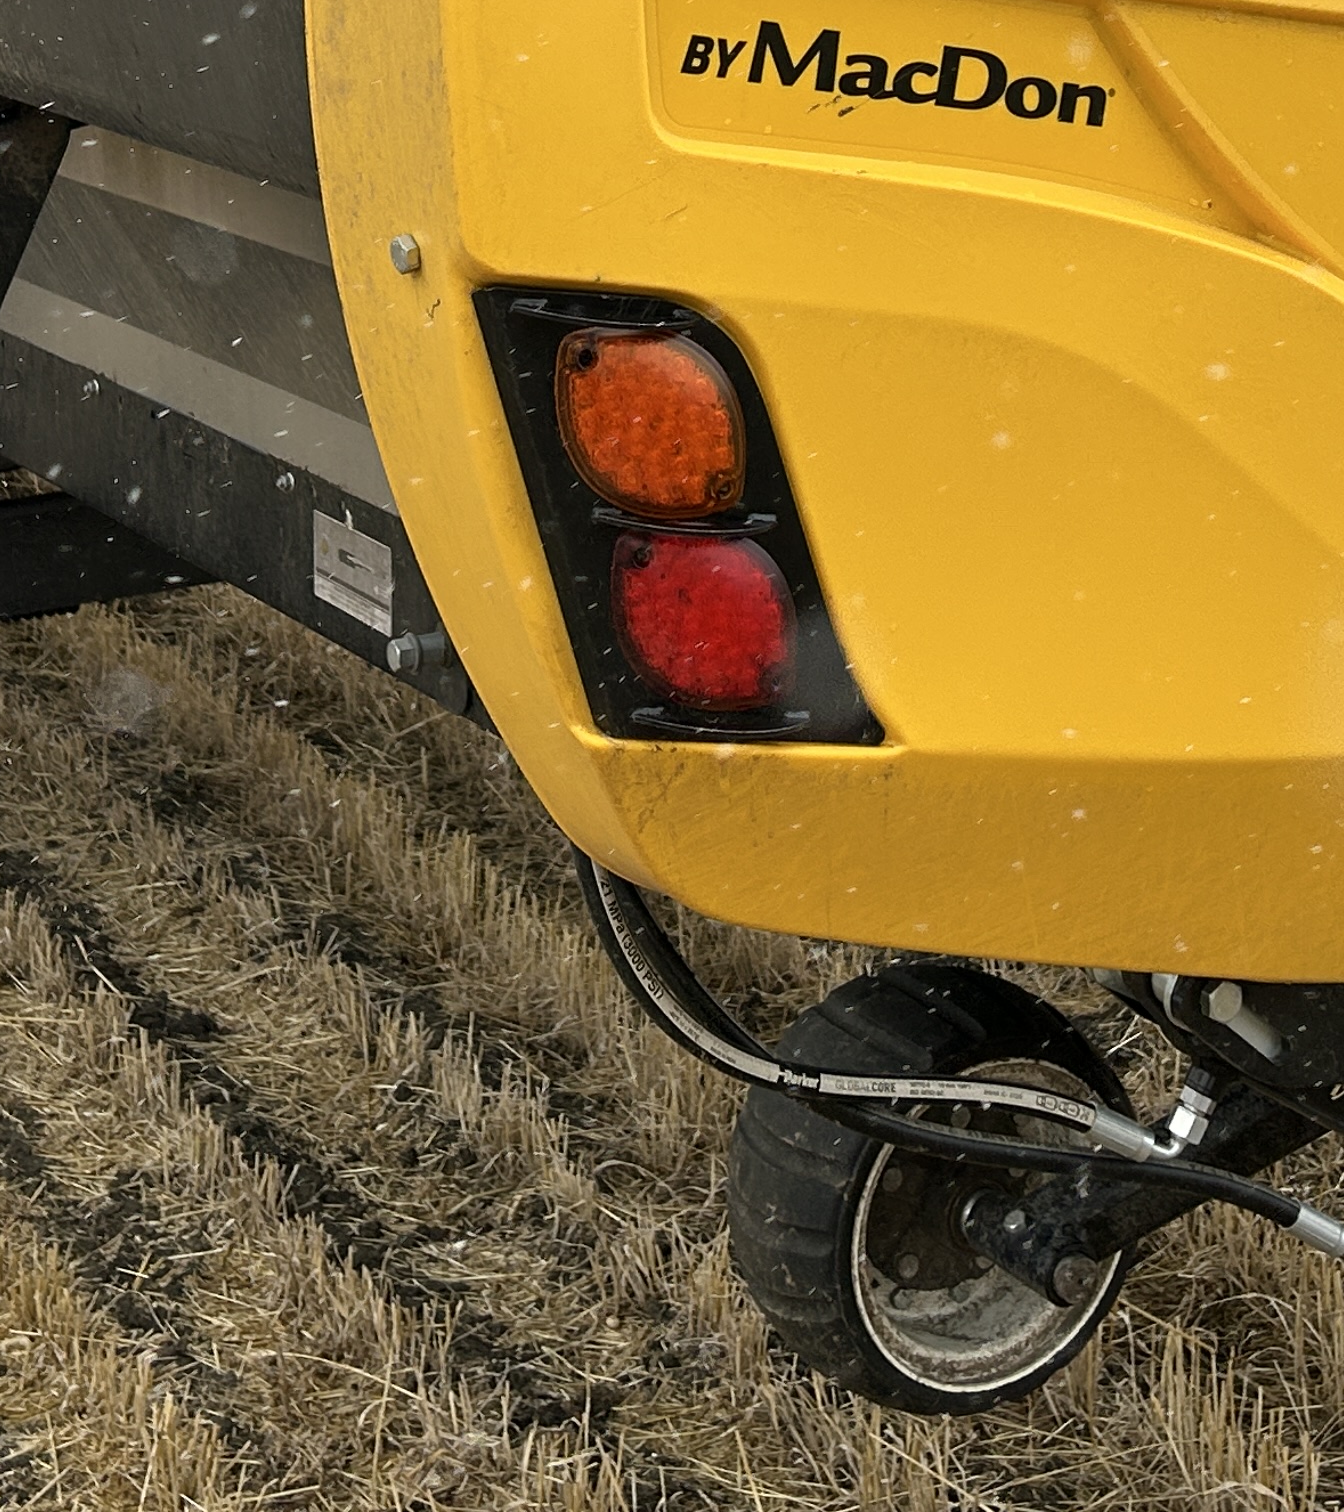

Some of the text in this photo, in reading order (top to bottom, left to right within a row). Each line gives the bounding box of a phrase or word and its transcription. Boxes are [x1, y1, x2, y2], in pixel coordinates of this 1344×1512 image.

[680, 19, 1107, 127] BY MacDon
[599, 877, 665, 1001] 21 MPa (3000 PSI)
